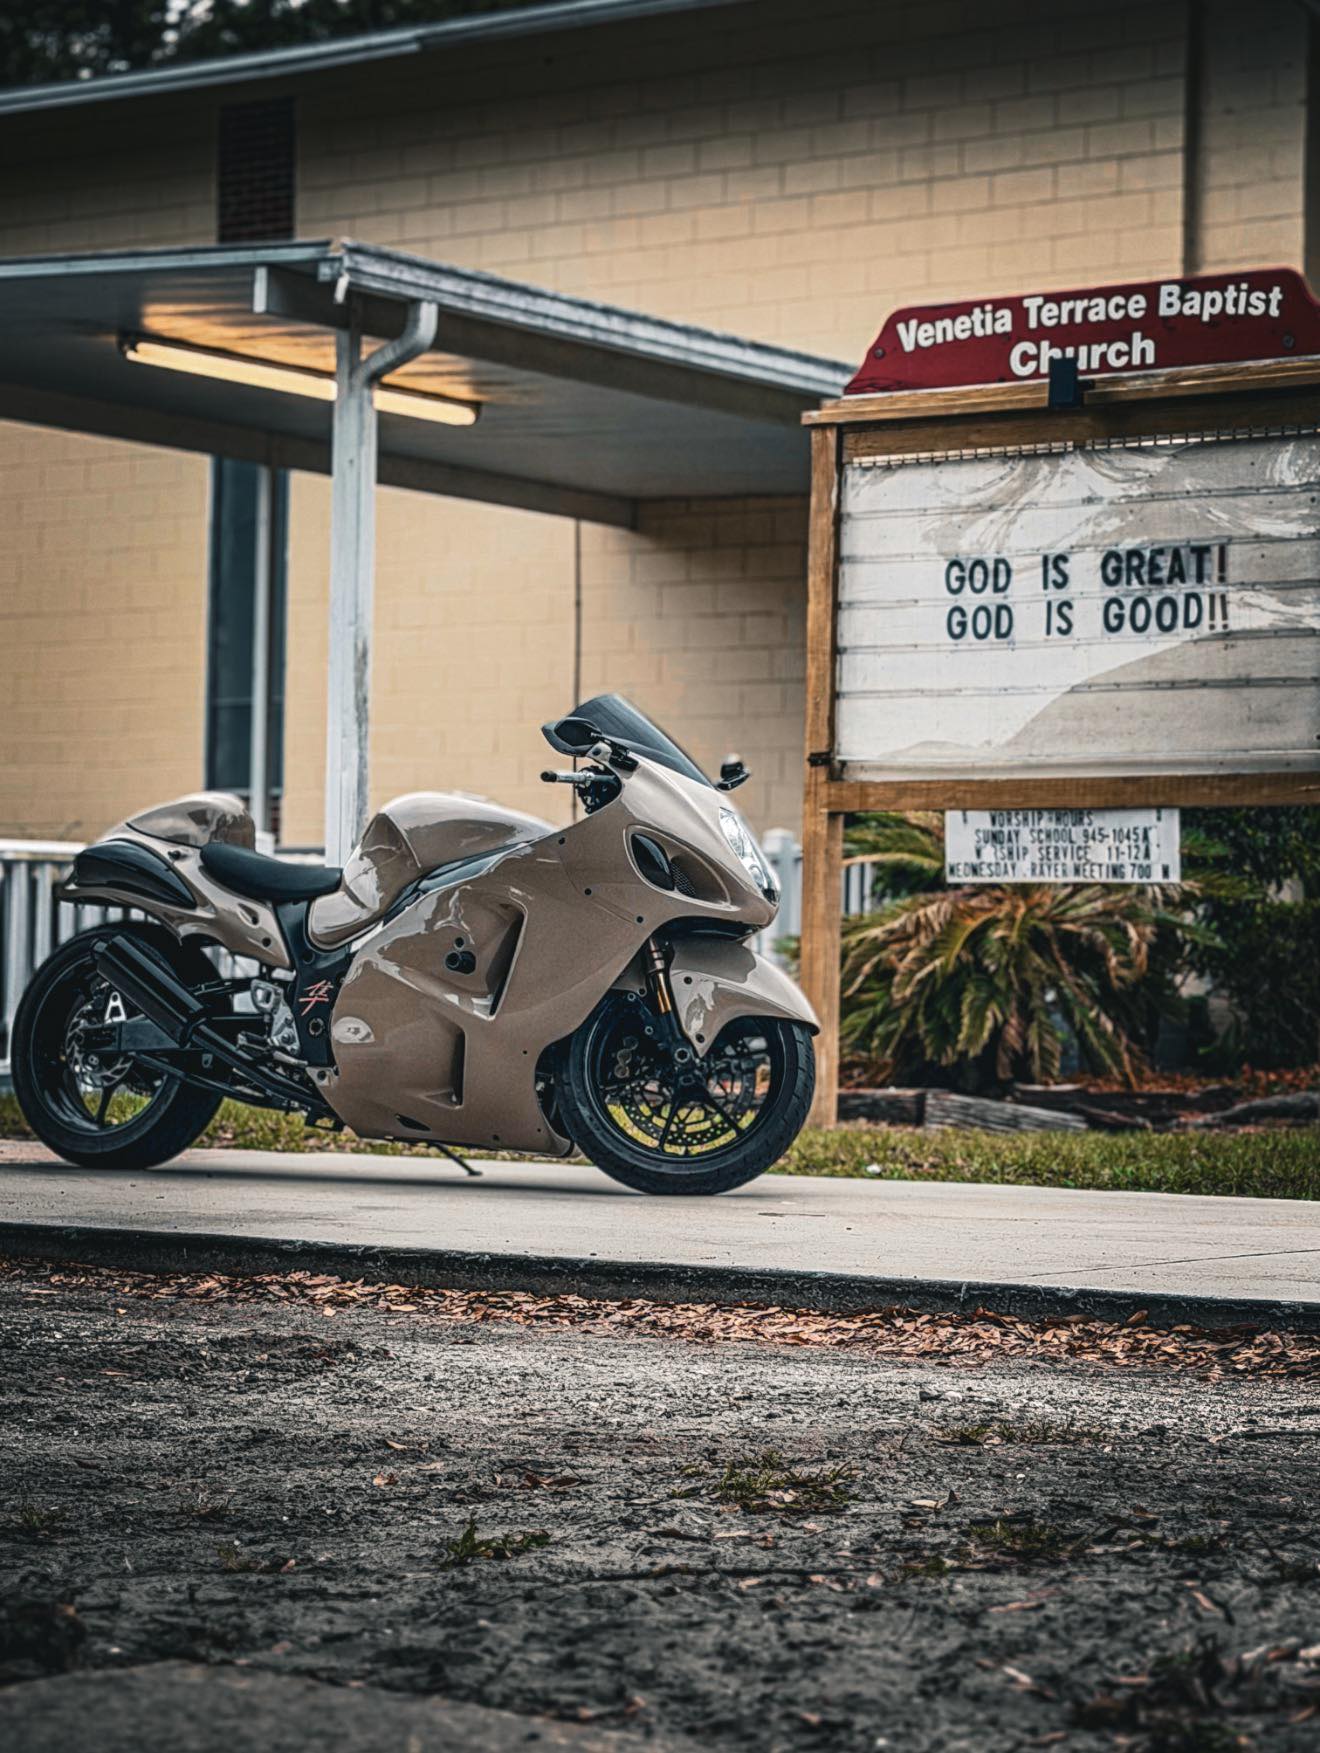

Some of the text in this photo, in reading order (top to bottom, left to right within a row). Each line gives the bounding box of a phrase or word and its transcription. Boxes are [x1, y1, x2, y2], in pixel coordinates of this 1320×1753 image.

[896, 282, 1284, 353] Venetia Terrace Baptist
[945, 545, 1227, 595] GOD IS GREAT!
[946, 592, 1229, 640] GOD IS GOOD!!
[989, 809, 1093, 828] WORSHIP HOURS
[975, 828, 1020, 845] SUNDAY
[1029, 828, 1076, 845] SCHOOL
[975, 845, 1029, 861] WSHIP
[1038, 845, 1090, 862] SERVICE
[948, 861, 1016, 878] WEDNESDAY
[1023, 861, 1068, 878] RAYER
[1073, 861, 1126, 879] MEETING
